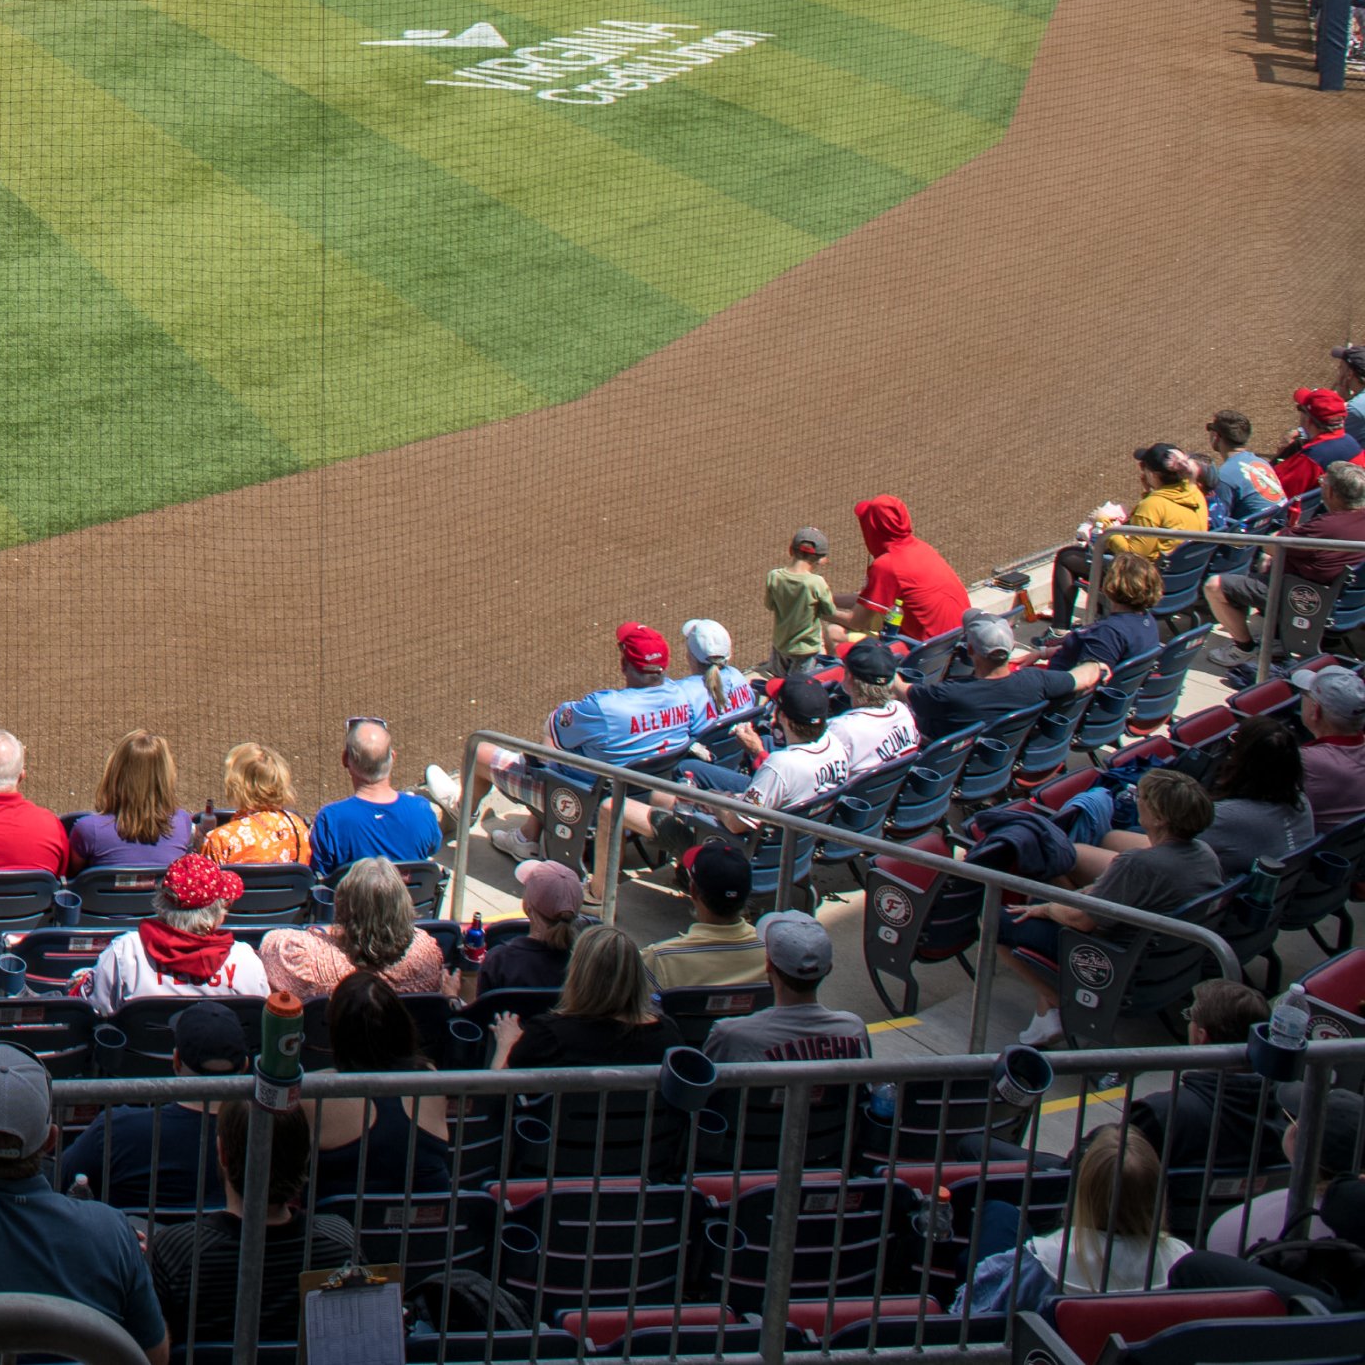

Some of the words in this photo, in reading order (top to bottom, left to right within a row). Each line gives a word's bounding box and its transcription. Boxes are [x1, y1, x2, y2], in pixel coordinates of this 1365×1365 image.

[425, 20, 700, 91] VIRGINIA
[537, 62, 681, 105] Credit
[650, 29, 776, 66] Union
[630, 704, 689, 734] ALLWINE
[884, 931, 892, 940] C
[1083, 993, 1091, 1004] D
